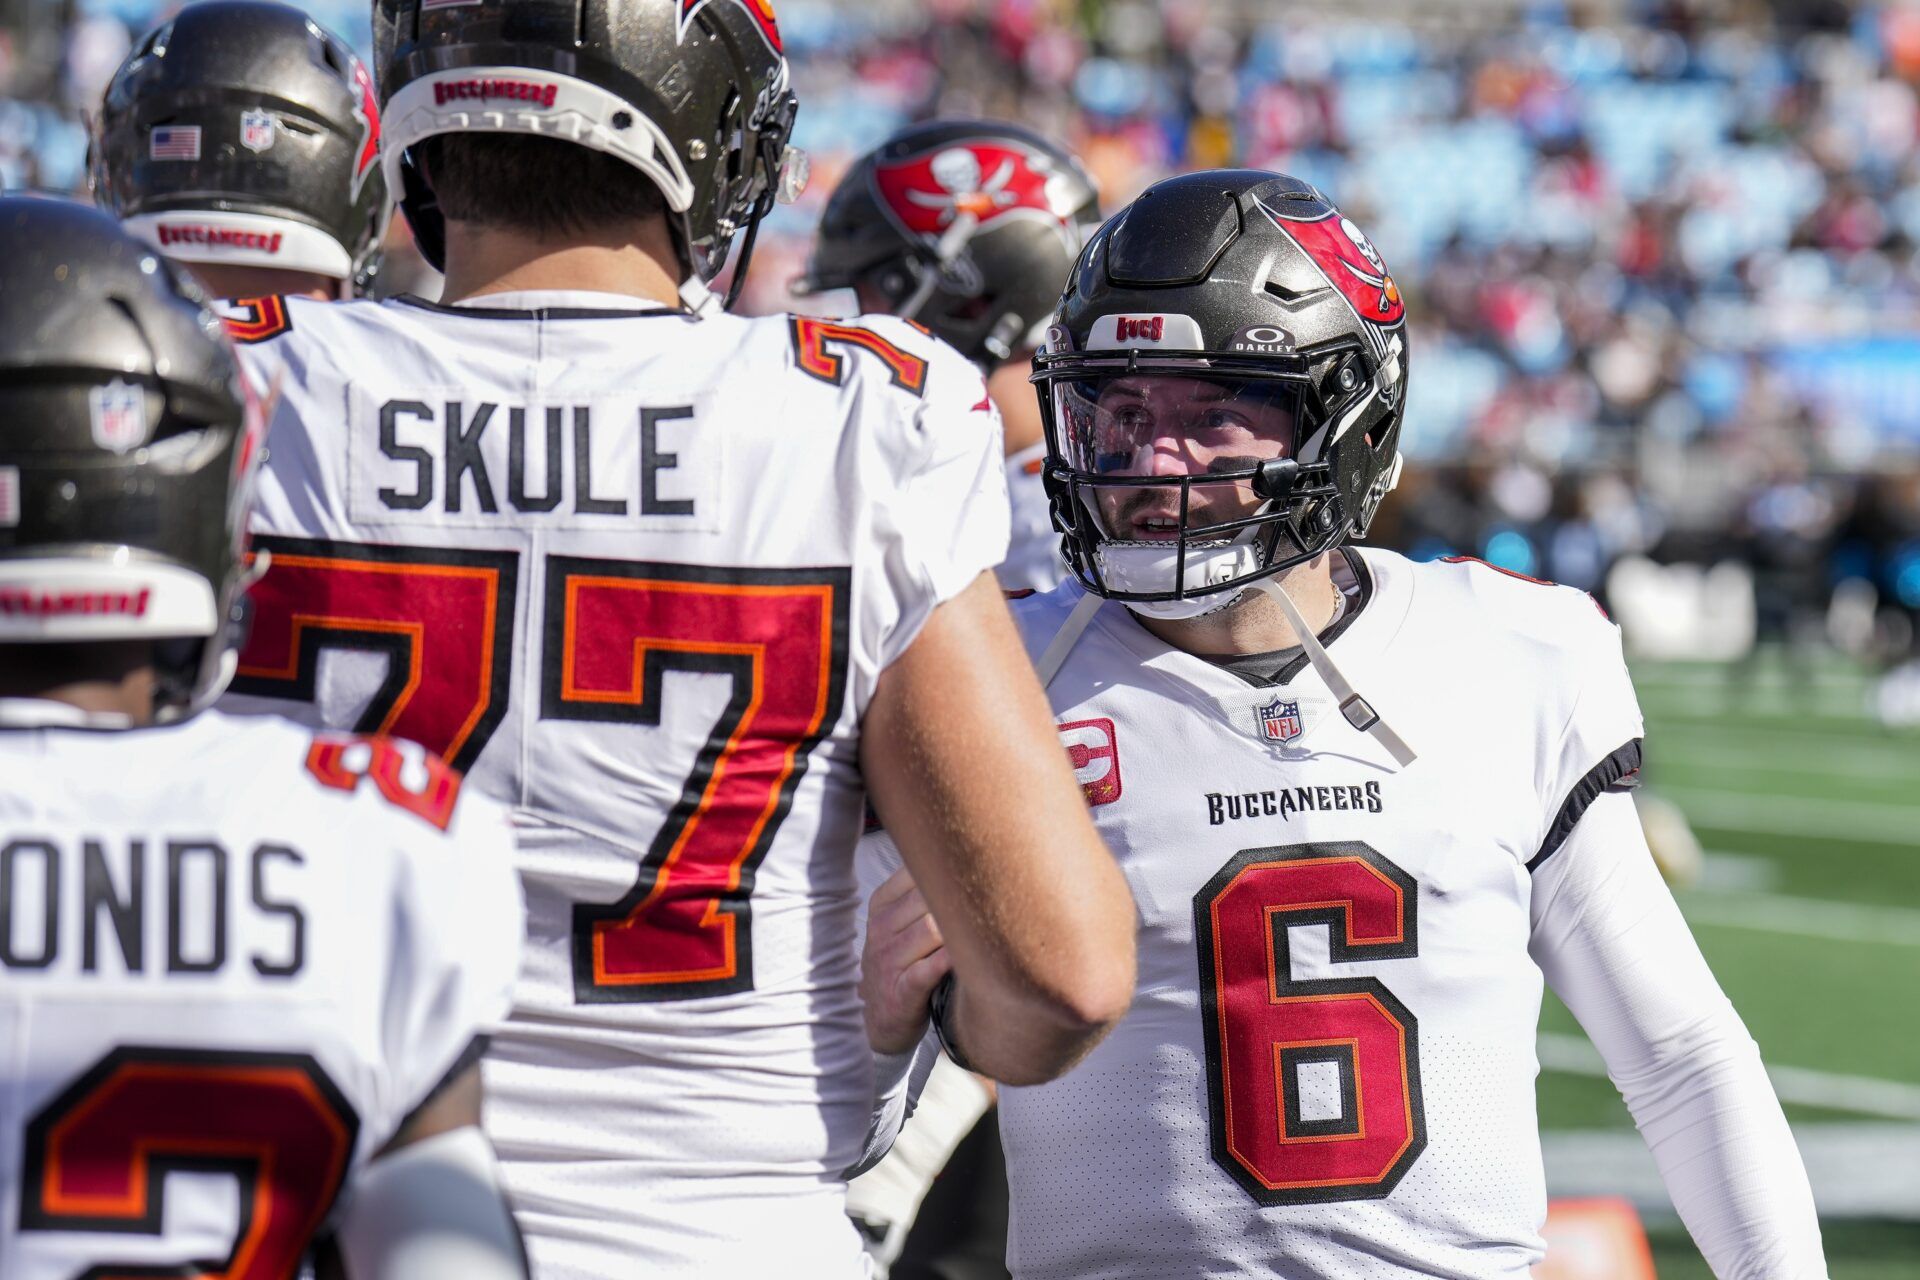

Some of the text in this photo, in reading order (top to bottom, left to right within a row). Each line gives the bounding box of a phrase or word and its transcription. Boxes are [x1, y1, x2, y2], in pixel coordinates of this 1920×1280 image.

[1116, 317, 1163, 342] BUCS
[1236, 343, 1292, 352] OAKLEY
[378, 399, 695, 516] SKULE
[224, 533, 849, 1005] 77
[1266, 718, 1300, 740] NFL
[1205, 781, 1382, 827] BUCCANEERS
[0, 840, 304, 976] ONDS
[1193, 840, 1428, 1207] 6
